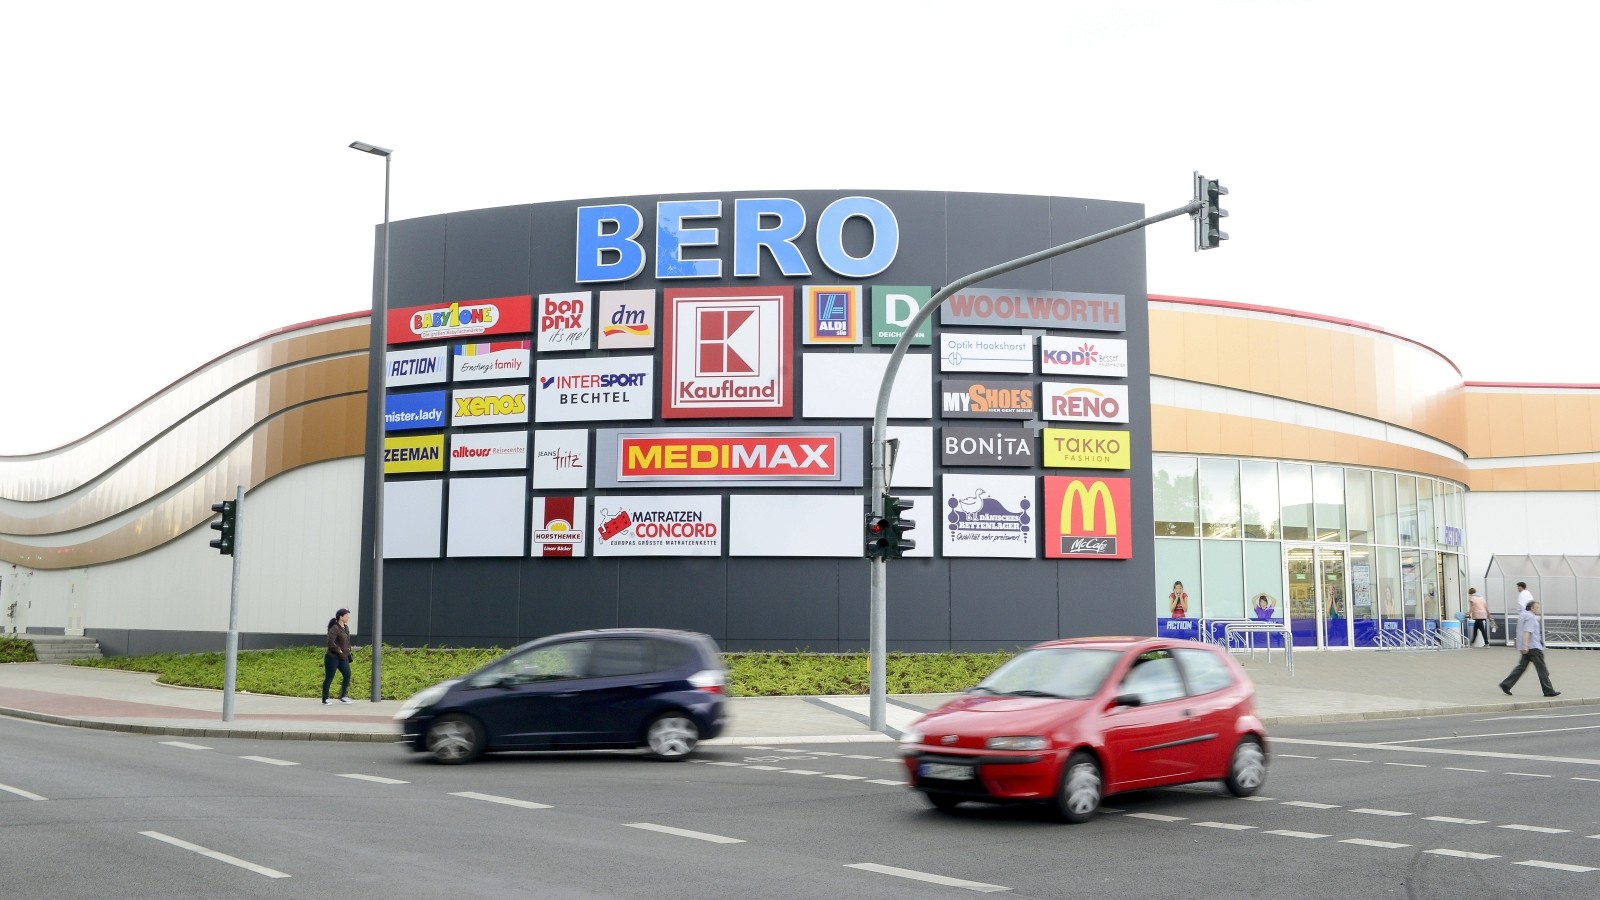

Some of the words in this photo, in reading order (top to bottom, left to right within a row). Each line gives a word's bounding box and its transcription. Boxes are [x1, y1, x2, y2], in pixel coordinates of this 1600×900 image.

[576, 196, 899, 283] BERO
[545, 298, 584, 315] bon
[611, 304, 645, 324] dm
[886, 294, 920, 328] D
[949, 295, 1120, 324] WOOLWORTH
[541, 314, 582, 332] prix
[819, 322, 847, 331] ALDI
[548, 328, 565, 343] it's
[565, 327, 590, 346] me!
[700, 311, 755, 373] K
[948, 340, 973, 351] Optik
[391, 357, 437, 377] ACTION
[495, 358, 522, 372] family
[557, 373, 646, 390] INTERSPORT
[680, 380, 775, 399] Kaufland
[455, 394, 526, 418] xenos
[560, 392, 630, 405] BECHTEL
[1052, 395, 1120, 419] RENO
[384, 446, 439, 462] ZEEMAN
[452, 446, 491, 458] alltours
[492, 446, 525, 455] Reisecenter
[538, 450, 557, 458] JEANS
[552, 447, 583, 470] fritz
[628, 444, 829, 470] MEDIMAX
[1064, 455, 1110, 463] FASHION
[632, 511, 702, 523] MATRATZEN
[979, 512, 1020, 522] DÄNISCHES
[635, 522, 717, 538] CONCORD
[959, 522, 1020, 531] BETTENLAGER
[956, 532, 980, 541] Qualität
[981, 533, 994, 541] sehr
[1071, 538, 1108, 552] McCafé
[1166, 620, 1193, 630] ACTION
